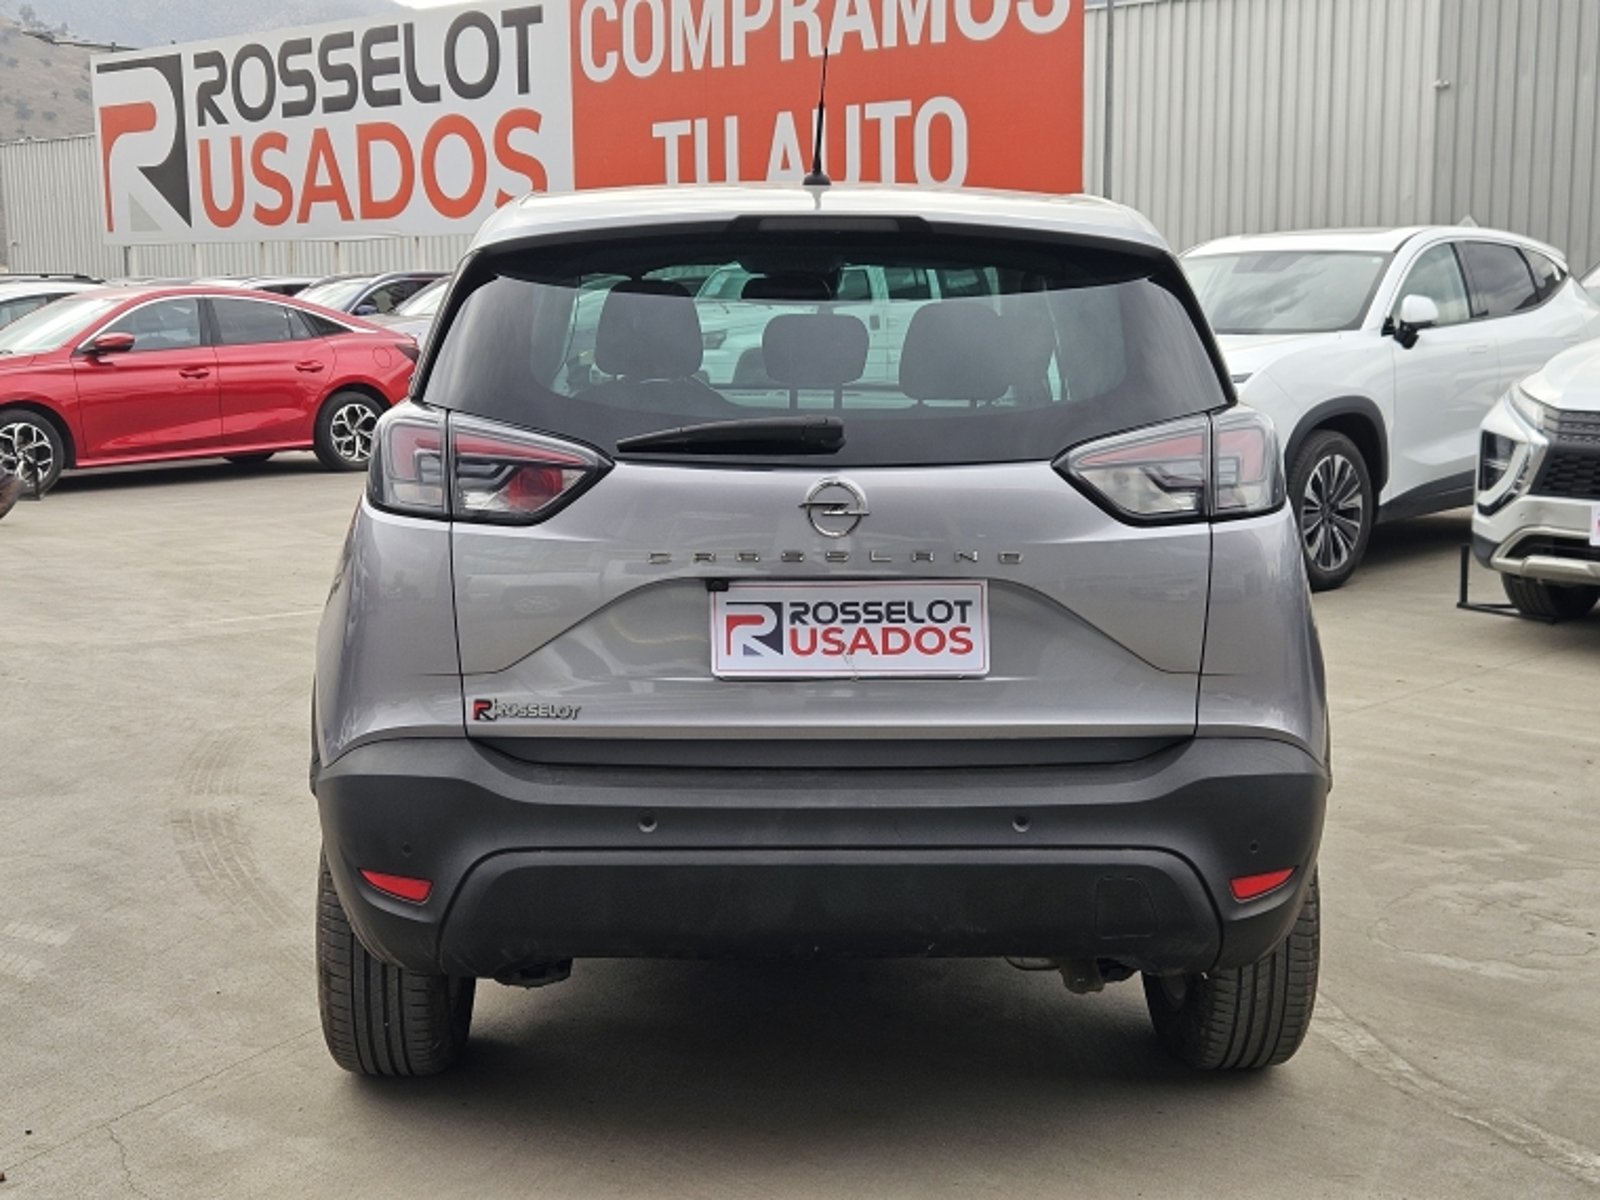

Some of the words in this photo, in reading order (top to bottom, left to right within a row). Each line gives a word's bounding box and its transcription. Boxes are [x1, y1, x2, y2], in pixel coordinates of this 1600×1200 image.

[194, 5, 543, 127] ROSSELOT
[199, 108, 548, 229] USADOS
[648, 550, 1023, 565] CROSSLAND
[789, 600, 973, 624] ROSSELOT
[790, 626, 974, 656] USADOS
